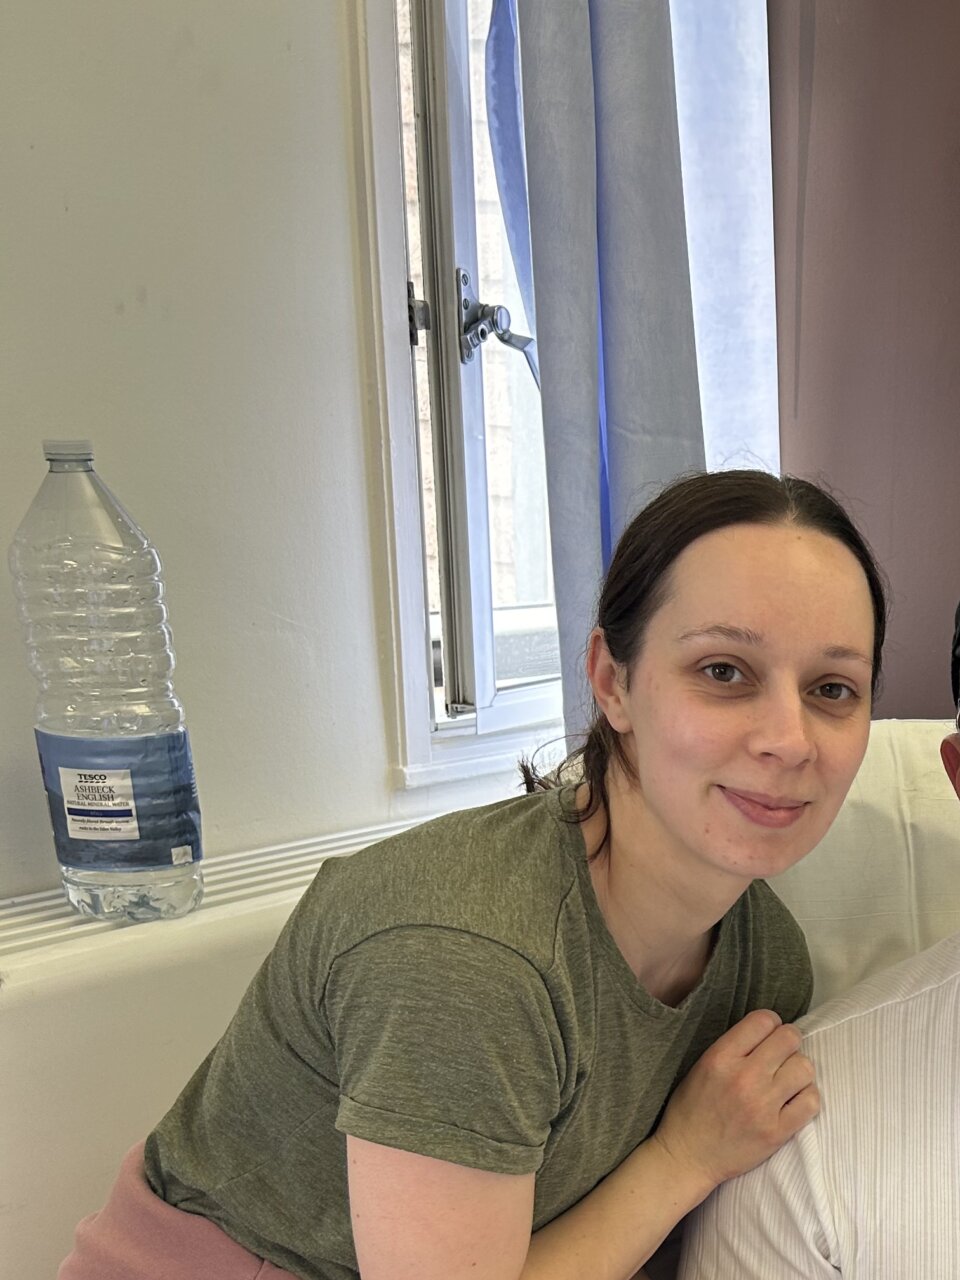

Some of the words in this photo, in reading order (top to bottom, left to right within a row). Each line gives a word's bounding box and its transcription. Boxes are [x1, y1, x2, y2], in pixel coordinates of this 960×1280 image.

[77, 773, 107, 781] TESCO
[74, 785, 116, 794] ASHBECK
[77, 792, 115, 802] ENGLISH
